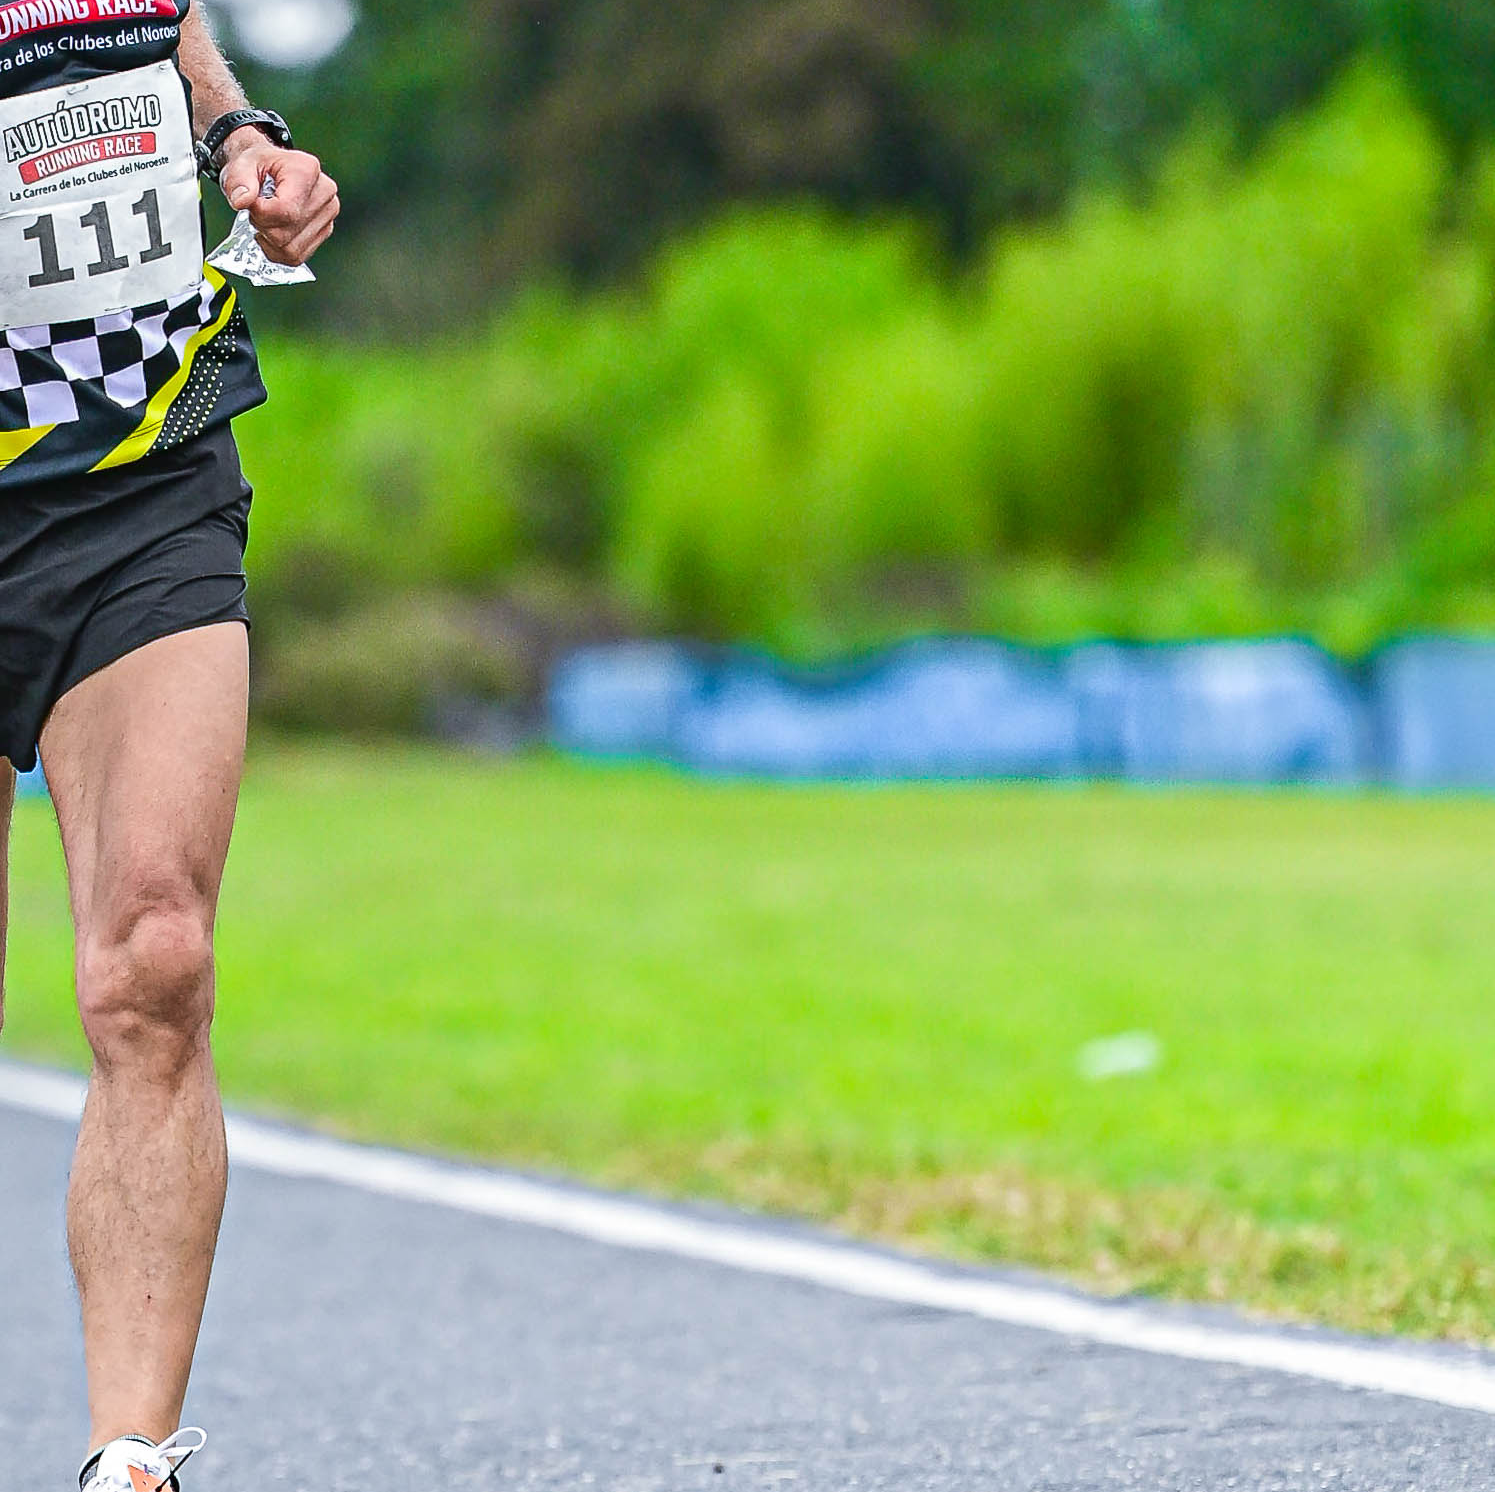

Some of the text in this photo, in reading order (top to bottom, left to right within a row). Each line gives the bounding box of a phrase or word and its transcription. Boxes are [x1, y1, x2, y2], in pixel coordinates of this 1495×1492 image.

[15, 48, 34, 67] de
[34, 42, 54, 60] los
[57, 33, 113, 50] Clubes
[116, 27, 139, 47] del
[3, 94, 162, 163] AUTÓDROMO
[9, 155, 169, 202] La Carrera de los Clubes del Noroeste
[34, 135, 143, 178] RUNNING RACE
[23, 188, 172, 288] 111
